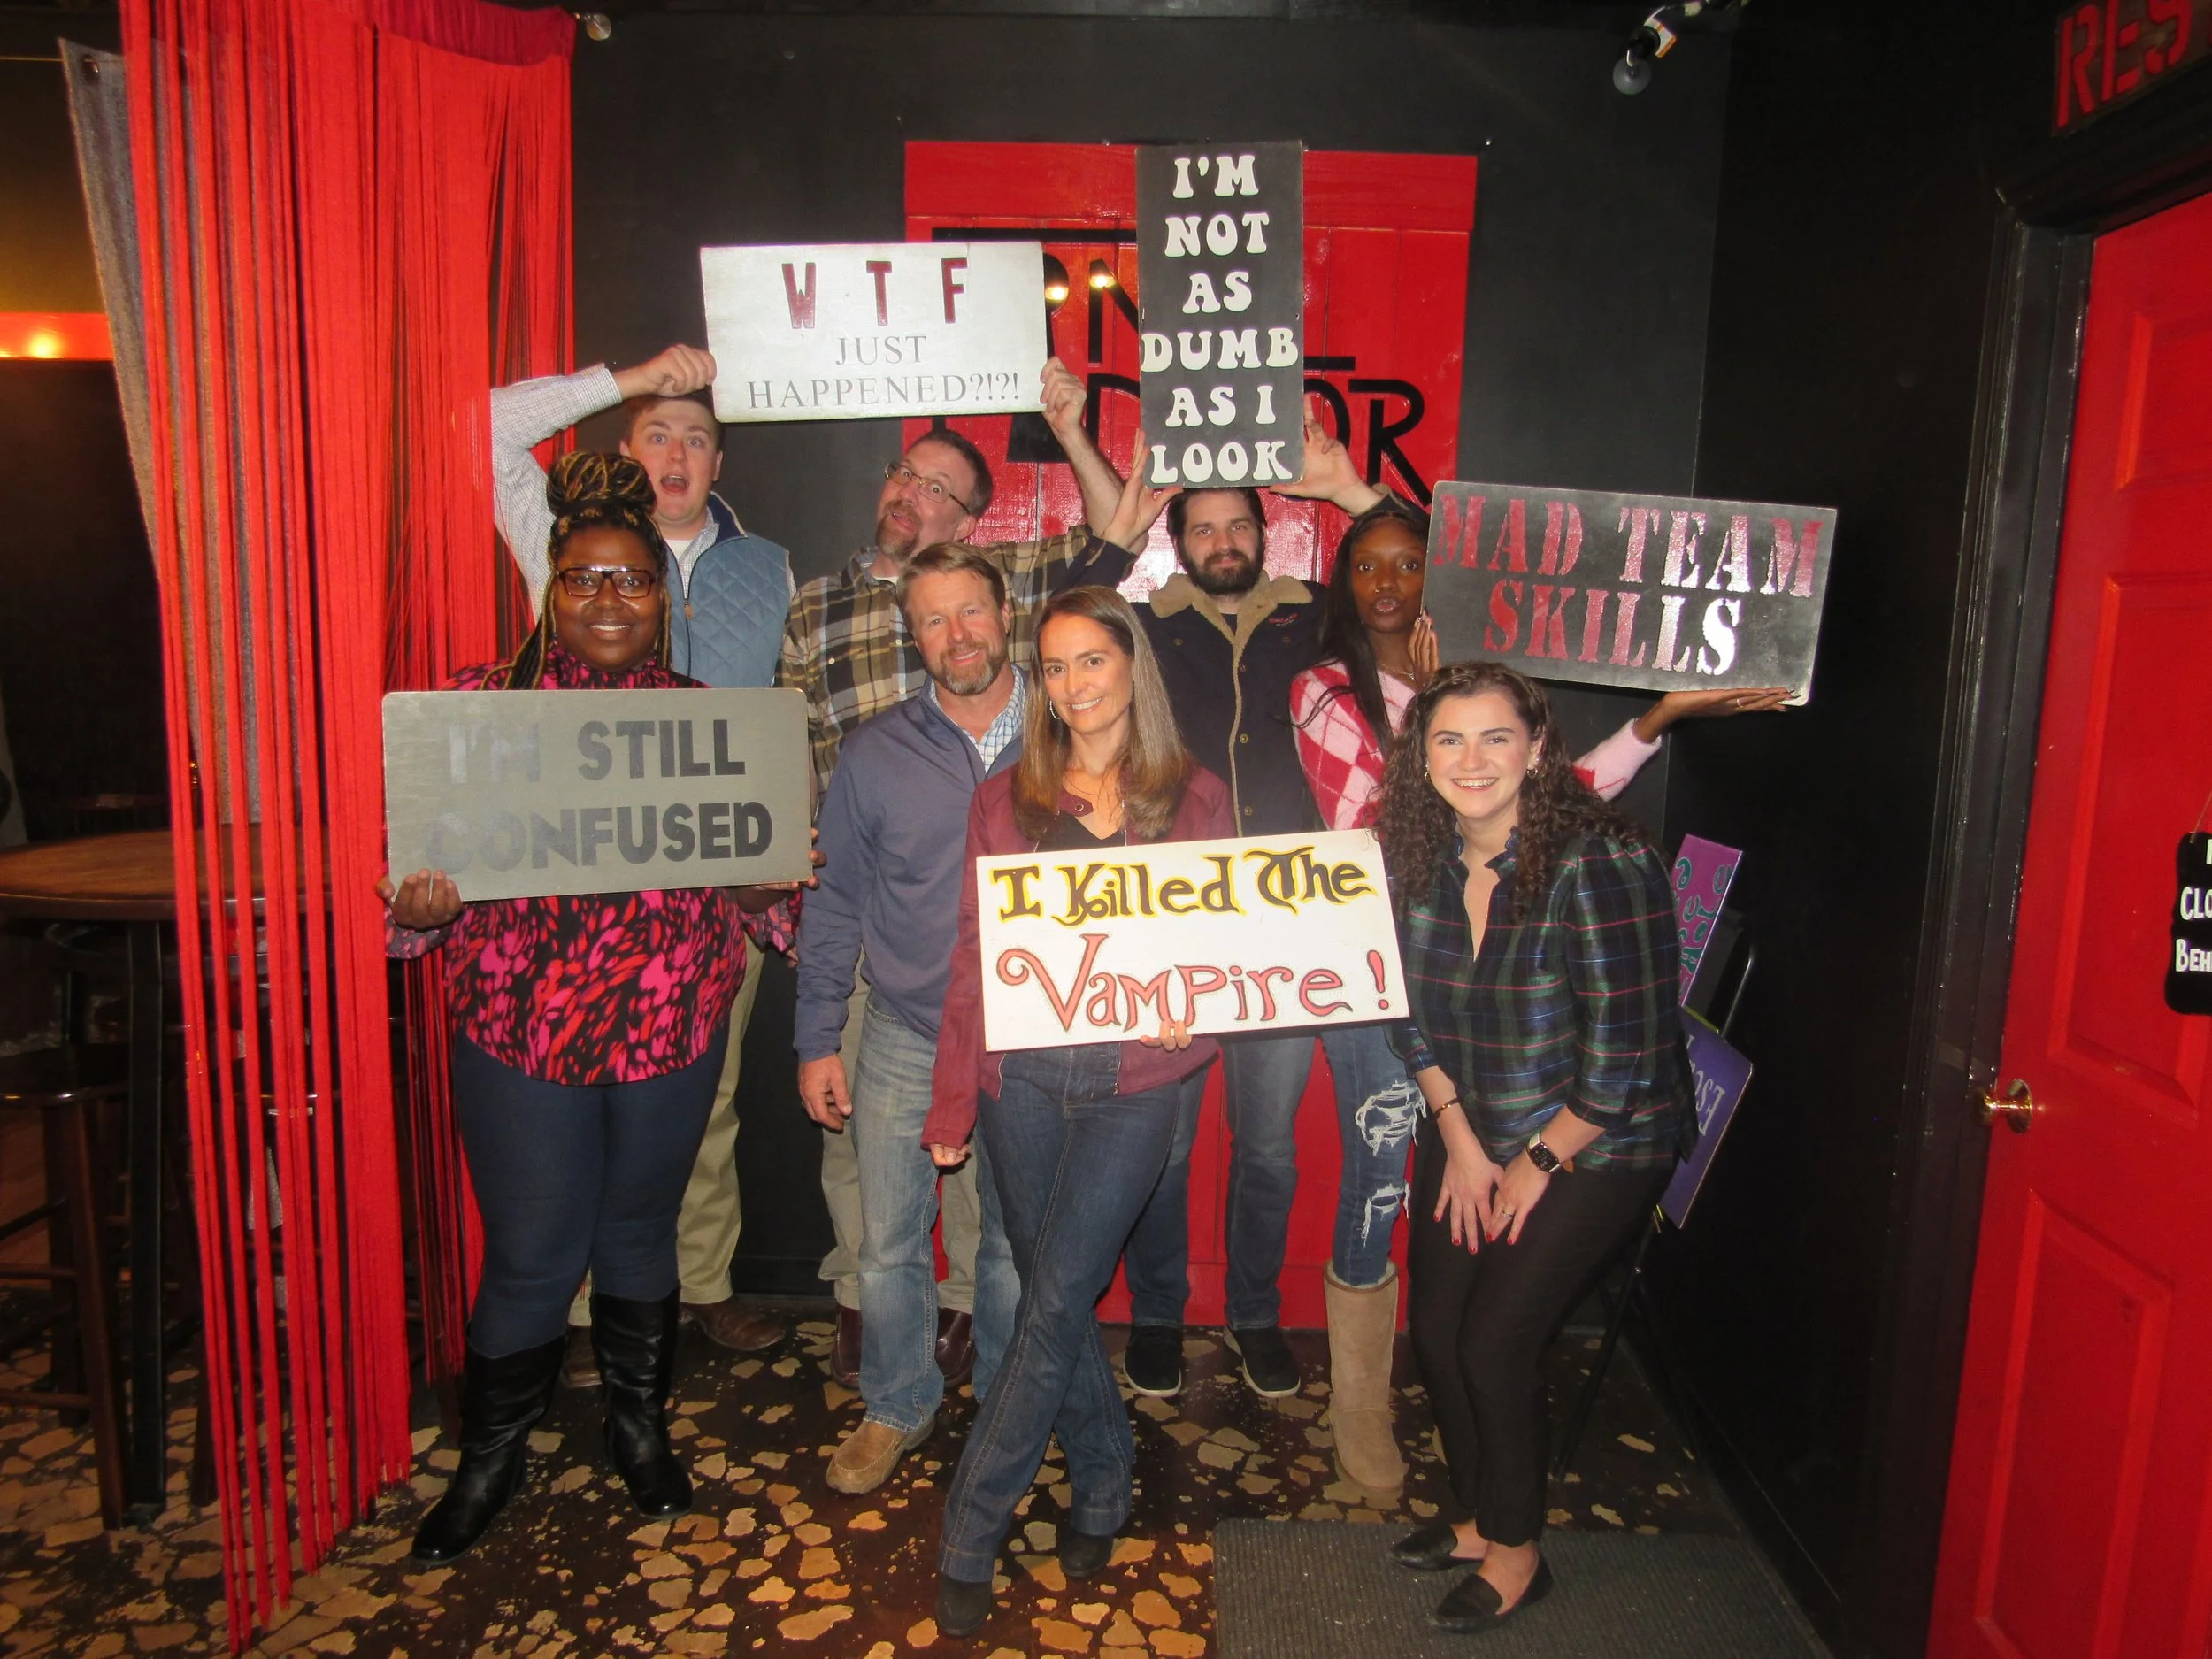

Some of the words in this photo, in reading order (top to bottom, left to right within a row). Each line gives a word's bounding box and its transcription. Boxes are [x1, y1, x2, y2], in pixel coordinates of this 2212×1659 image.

[2058, 0, 2212, 127] RES
[1173, 154, 1259, 199] I'M
[1164, 212, 1270, 257] NOT
[1183, 271, 1252, 315] AS
[834, 335, 927, 366] JUST
[1141, 327, 1299, 373] DUMB
[748, 373, 1019, 409] HAPPENED?!?!
[1165, 387, 1236, 427] AS
[1255, 385, 1277, 425] I
[1150, 441, 1293, 485] LOOK
[1432, 494, 1584, 576] MAD
[1617, 507, 1824, 597] TEAM
[1483, 580, 1741, 676] SKILLS
[449, 721, 541, 784] I'M
[577, 718, 746, 781] STILL
[425, 801, 772, 875] CONFUSED
[992, 864, 1042, 921] I
[1050, 854, 1246, 927] Killed
[1243, 846, 1377, 916] The
